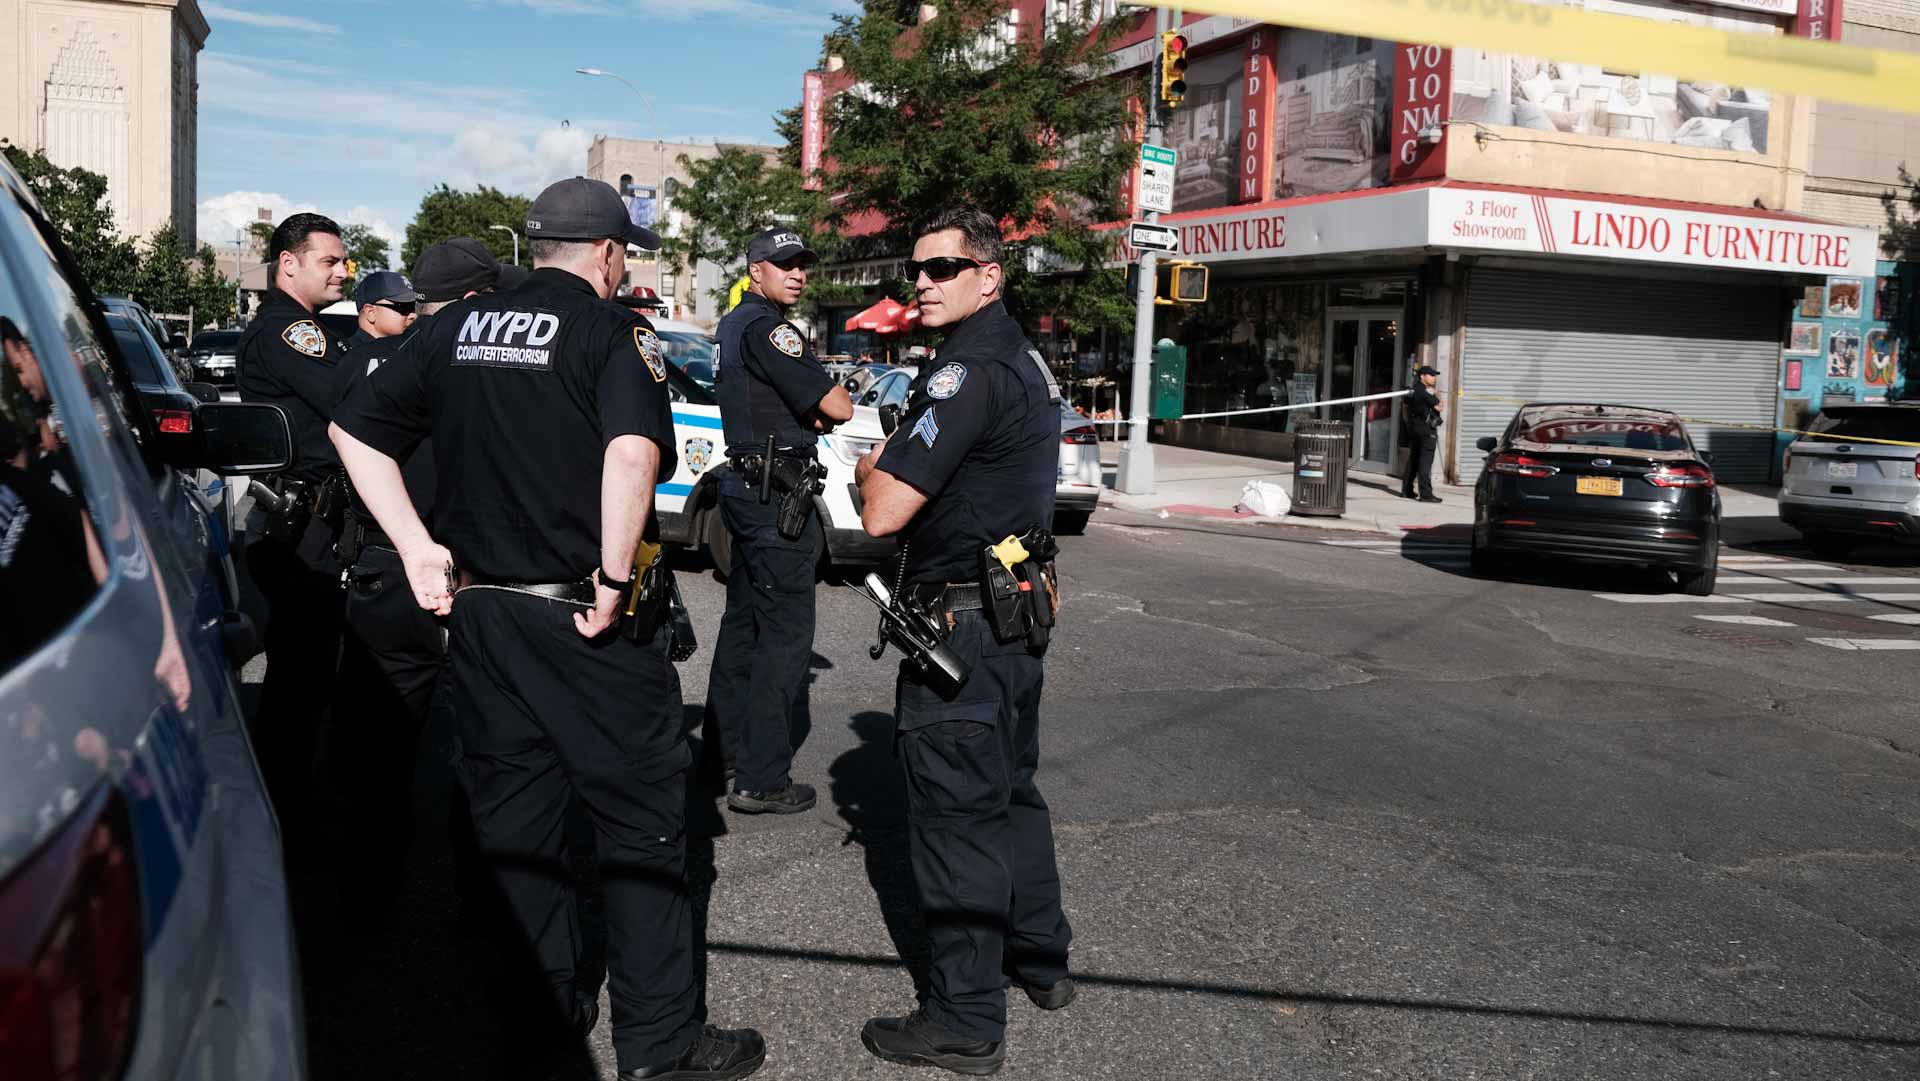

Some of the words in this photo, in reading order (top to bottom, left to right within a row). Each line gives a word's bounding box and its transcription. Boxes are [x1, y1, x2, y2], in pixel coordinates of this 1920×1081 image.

[1248, 34, 1261, 96] BED
[1400, 45, 1423, 165] VING
[1244, 108, 1258, 198] ROOM
[1141, 181, 1170, 195] SHARED
[1145, 195, 1165, 207] LANE
[1464, 200, 1474, 216] 3
[1481, 200, 1518, 219] Floor
[1135, 230, 1152, 241] ONE
[1159, 234, 1174, 246] WAY
[1172, 215, 1287, 256] URNITURE
[1452, 220, 1526, 241] Showroom
[1571, 210, 1671, 253] LINDO
[1684, 222, 1850, 268] FURNITURE
[457, 311, 560, 346] NYPD
[456, 345, 550, 366] COUNTERTERRORISM
